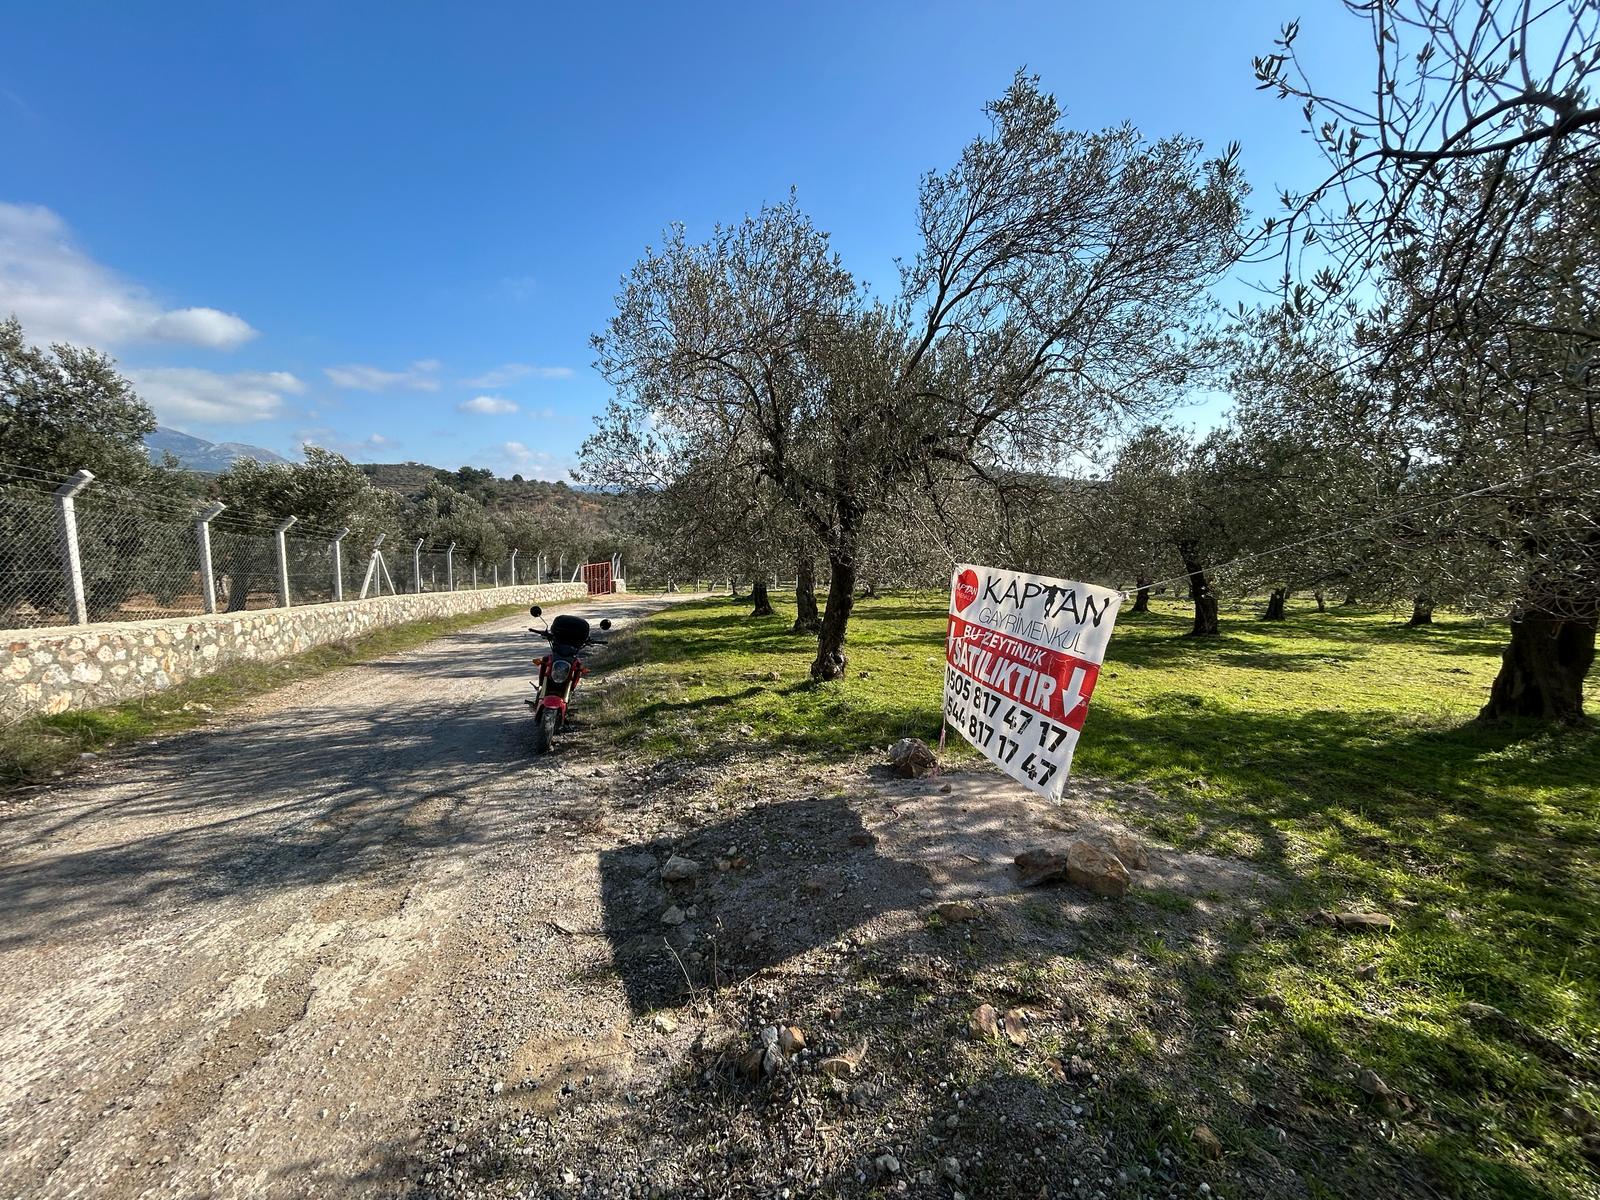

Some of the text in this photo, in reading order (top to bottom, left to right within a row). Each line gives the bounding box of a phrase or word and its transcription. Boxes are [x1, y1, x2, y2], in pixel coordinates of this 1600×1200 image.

[956, 582, 977, 596] APTAN
[983, 576, 1110, 628] KAPTAN
[964, 624, 981, 640] BU
[979, 607, 1086, 655] GAYRİMENKUL
[953, 637, 1057, 712] SATILIKTIR
[946, 694, 1058, 787] 544 817 17 47
[973, 686, 1002, 719] 817
[1003, 705, 1034, 736] 47
[1039, 720, 1068, 753] 17
